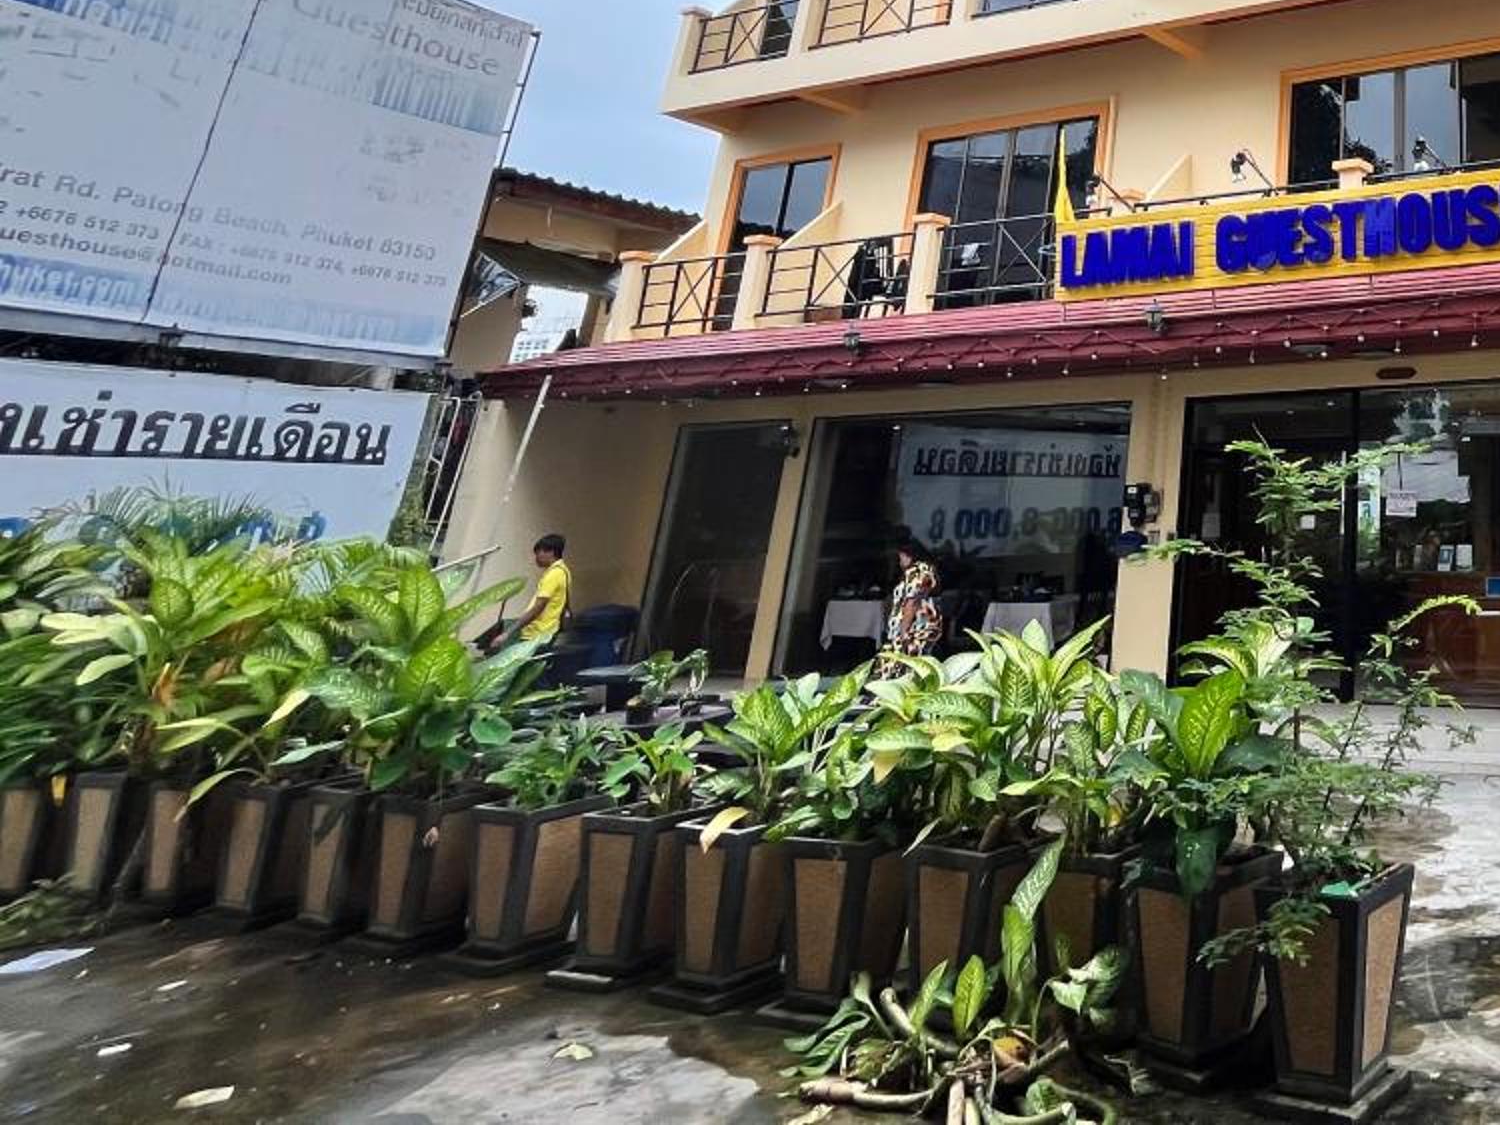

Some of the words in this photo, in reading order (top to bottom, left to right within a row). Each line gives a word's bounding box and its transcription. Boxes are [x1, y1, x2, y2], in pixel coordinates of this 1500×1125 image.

[0, 163, 45, 188] rat
[54, 175, 99, 200] Rd.
[1060, 221, 1195, 288] LAMAI
